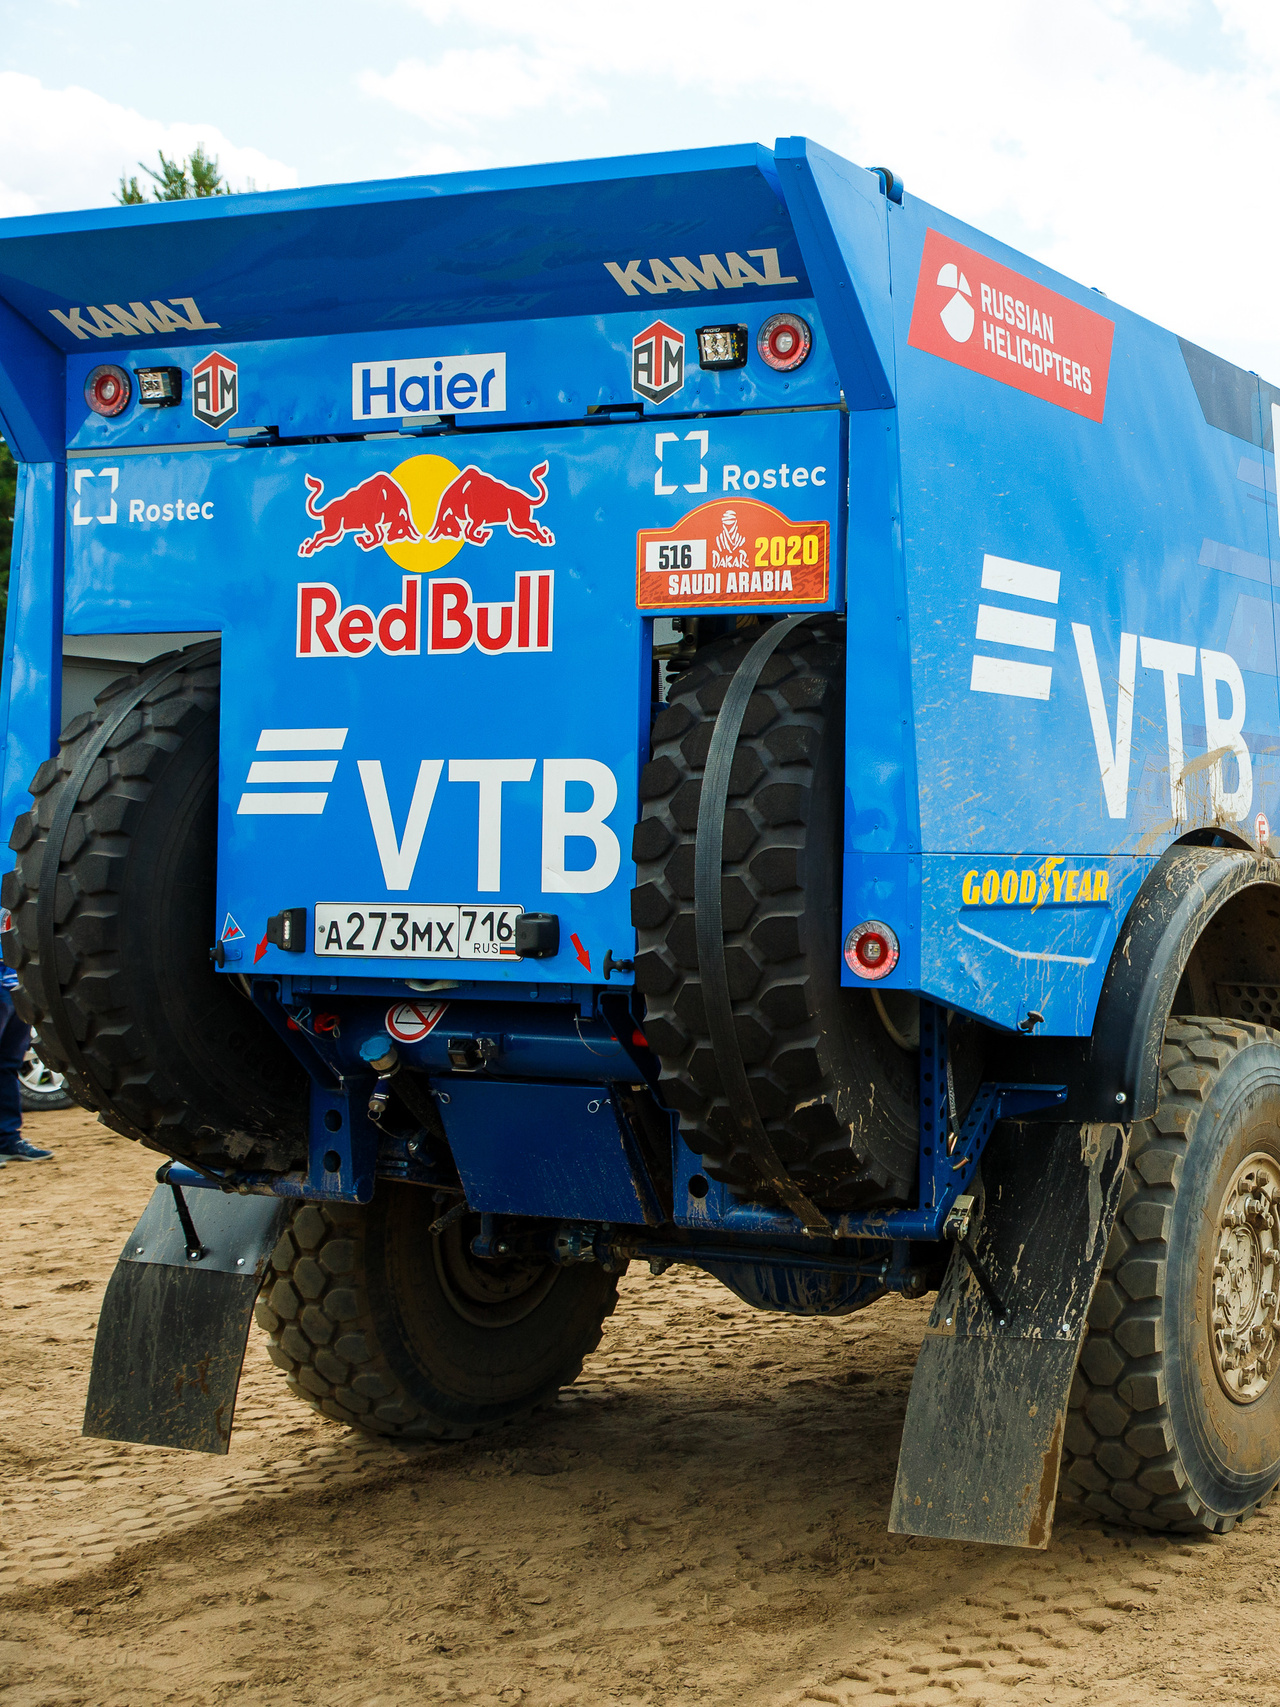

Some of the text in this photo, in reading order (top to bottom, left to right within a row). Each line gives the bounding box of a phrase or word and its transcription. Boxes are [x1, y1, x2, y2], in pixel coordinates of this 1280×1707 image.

[603, 248, 798, 296] KAMAZ
[49, 297, 221, 340] KAMAZ
[980, 282, 1054, 344] RUSSIAN
[982, 320, 1092, 395] HELICOPTERS
[362, 361, 496, 415] Haier
[722, 463, 826, 491] Rostec
[129, 498, 214, 523] Rostec
[659, 544, 692, 570] 516
[712, 550, 748, 569] DAKAR
[754, 534, 819, 567] 2020
[668, 570, 793, 595] SAUDI ARABIA
[299, 573, 551, 655] Red Bull
[1071, 622, 1254, 822] VTB
[357, 759, 621, 894] VTB
[462, 911, 513, 942] 716
[474, 943, 499, 954] RUS
